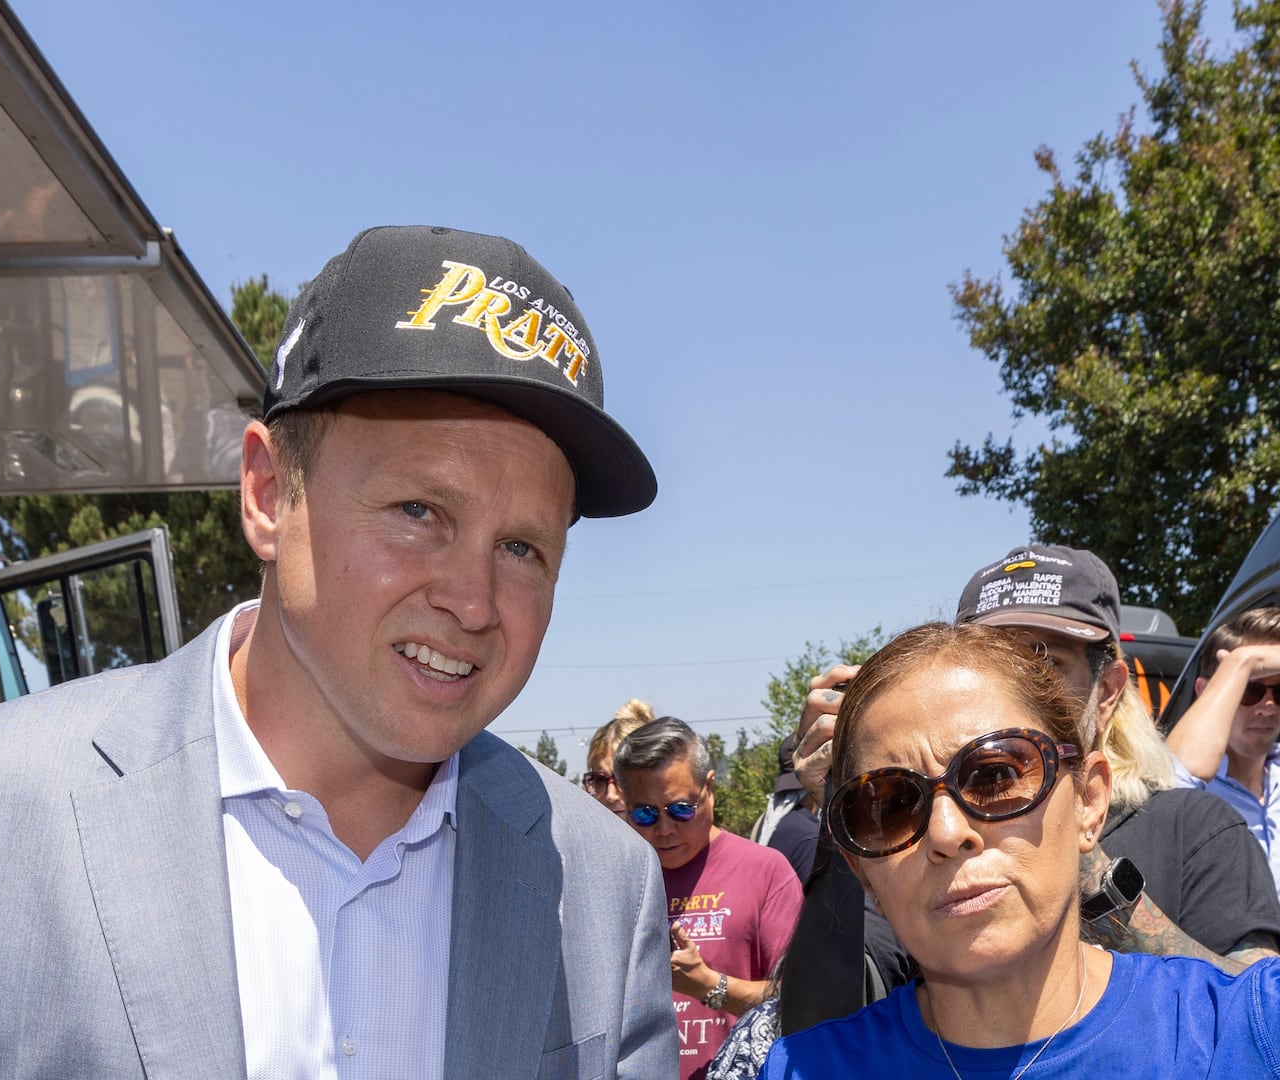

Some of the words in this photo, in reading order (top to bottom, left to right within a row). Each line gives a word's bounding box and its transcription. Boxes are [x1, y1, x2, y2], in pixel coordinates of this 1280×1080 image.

[489, 276, 532, 300] LOS
[395, 260, 589, 388] PRATT
[979, 583, 1014, 600] RUDOLPH
[1015, 581, 1062, 591] VALENTINO
[981, 576, 1012, 592] VIRGINIA
[1033, 573, 1064, 583] RAPPE
[1012, 589, 1061, 598] MANSFIELD
[976, 601, 1001, 614] CECIL
[1015, 596, 1061, 606] DEMILLE
[670, 891, 725, 911] PARTY
